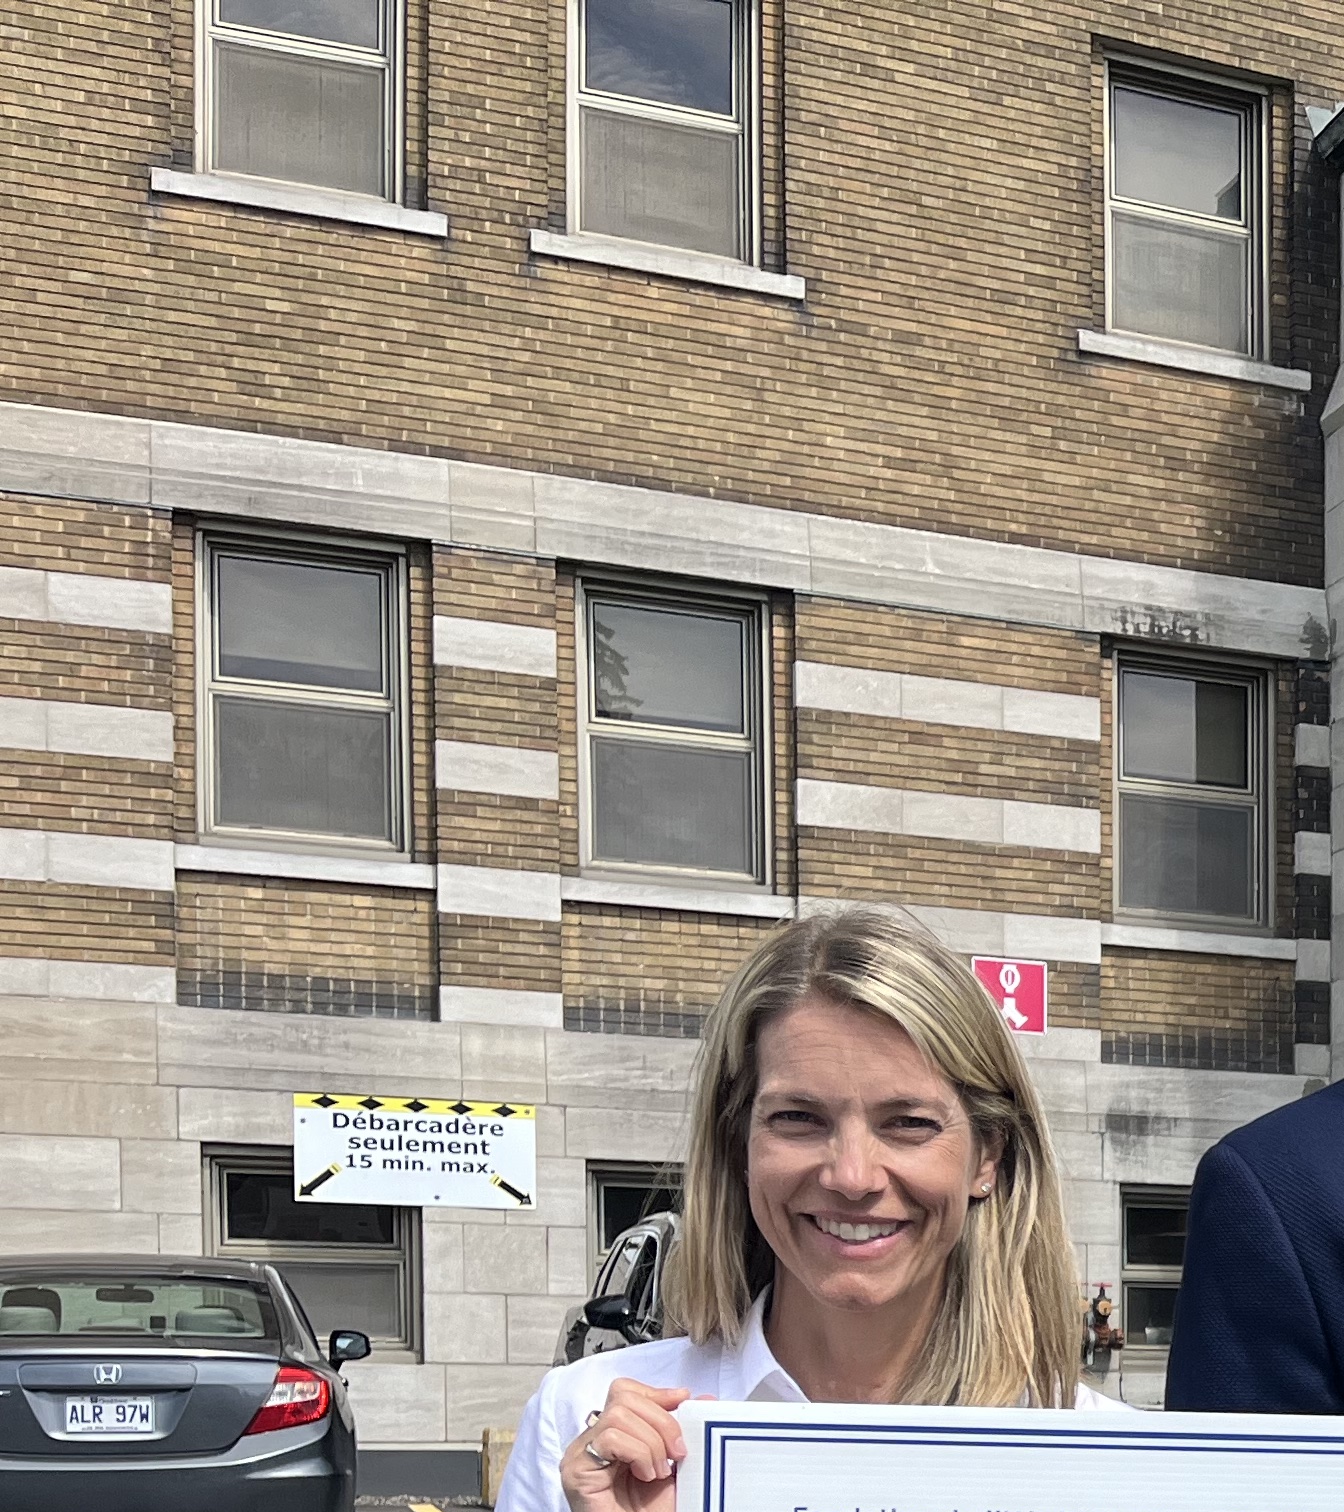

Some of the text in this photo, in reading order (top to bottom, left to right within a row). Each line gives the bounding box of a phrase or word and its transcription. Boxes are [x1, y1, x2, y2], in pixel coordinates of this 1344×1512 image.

[331, 1111, 505, 1137] Débarcadère
[348, 1134, 490, 1156] seulement
[346, 1153, 497, 1176] 15 min. max.
[70, 1405, 149, 1423] ALR 97W
